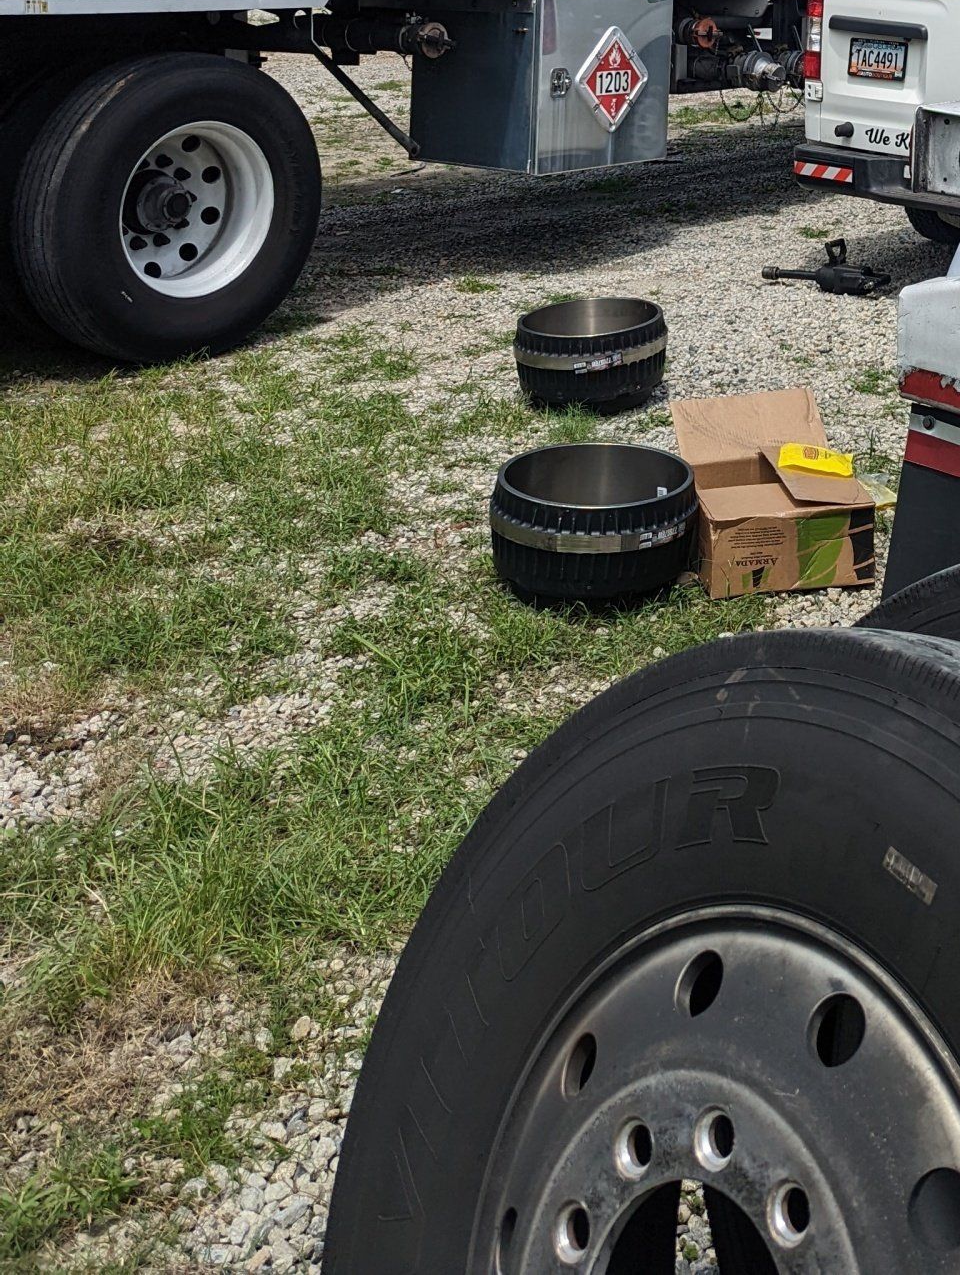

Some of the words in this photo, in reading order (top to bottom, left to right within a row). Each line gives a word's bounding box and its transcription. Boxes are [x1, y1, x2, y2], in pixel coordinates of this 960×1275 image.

[856, 48, 899, 71] TAC4491
[598, 70, 630, 94] 1203
[865, 127, 891, 146] We
[735, 557, 778, 567] ARMADA
